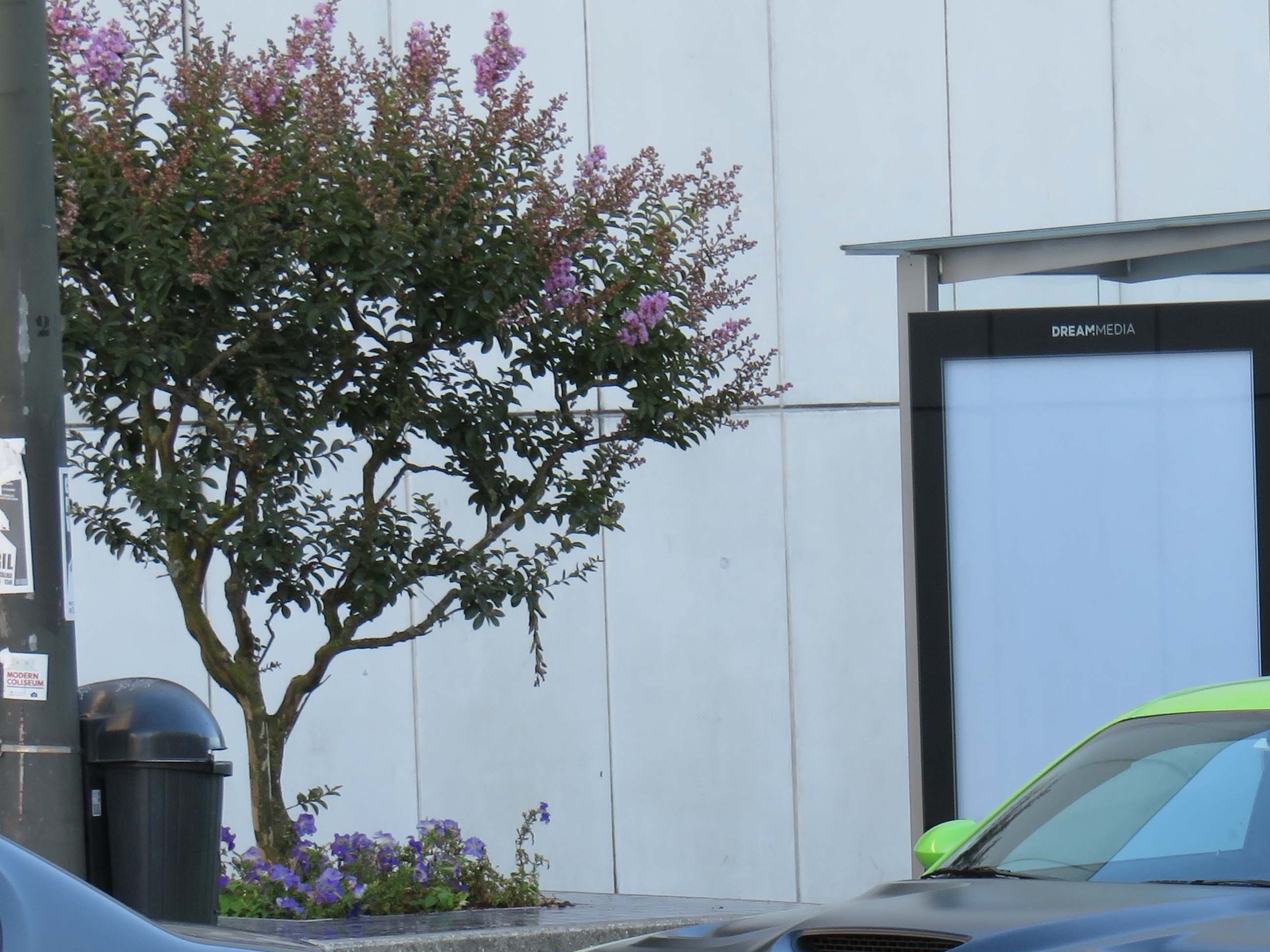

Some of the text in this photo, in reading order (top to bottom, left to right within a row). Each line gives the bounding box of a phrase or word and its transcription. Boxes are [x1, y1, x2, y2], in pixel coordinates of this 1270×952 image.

[1052, 323, 1136, 337] DREAMMEDIA
[7, 671, 39, 680] MODERN
[7, 678, 45, 687] COLISEUM
